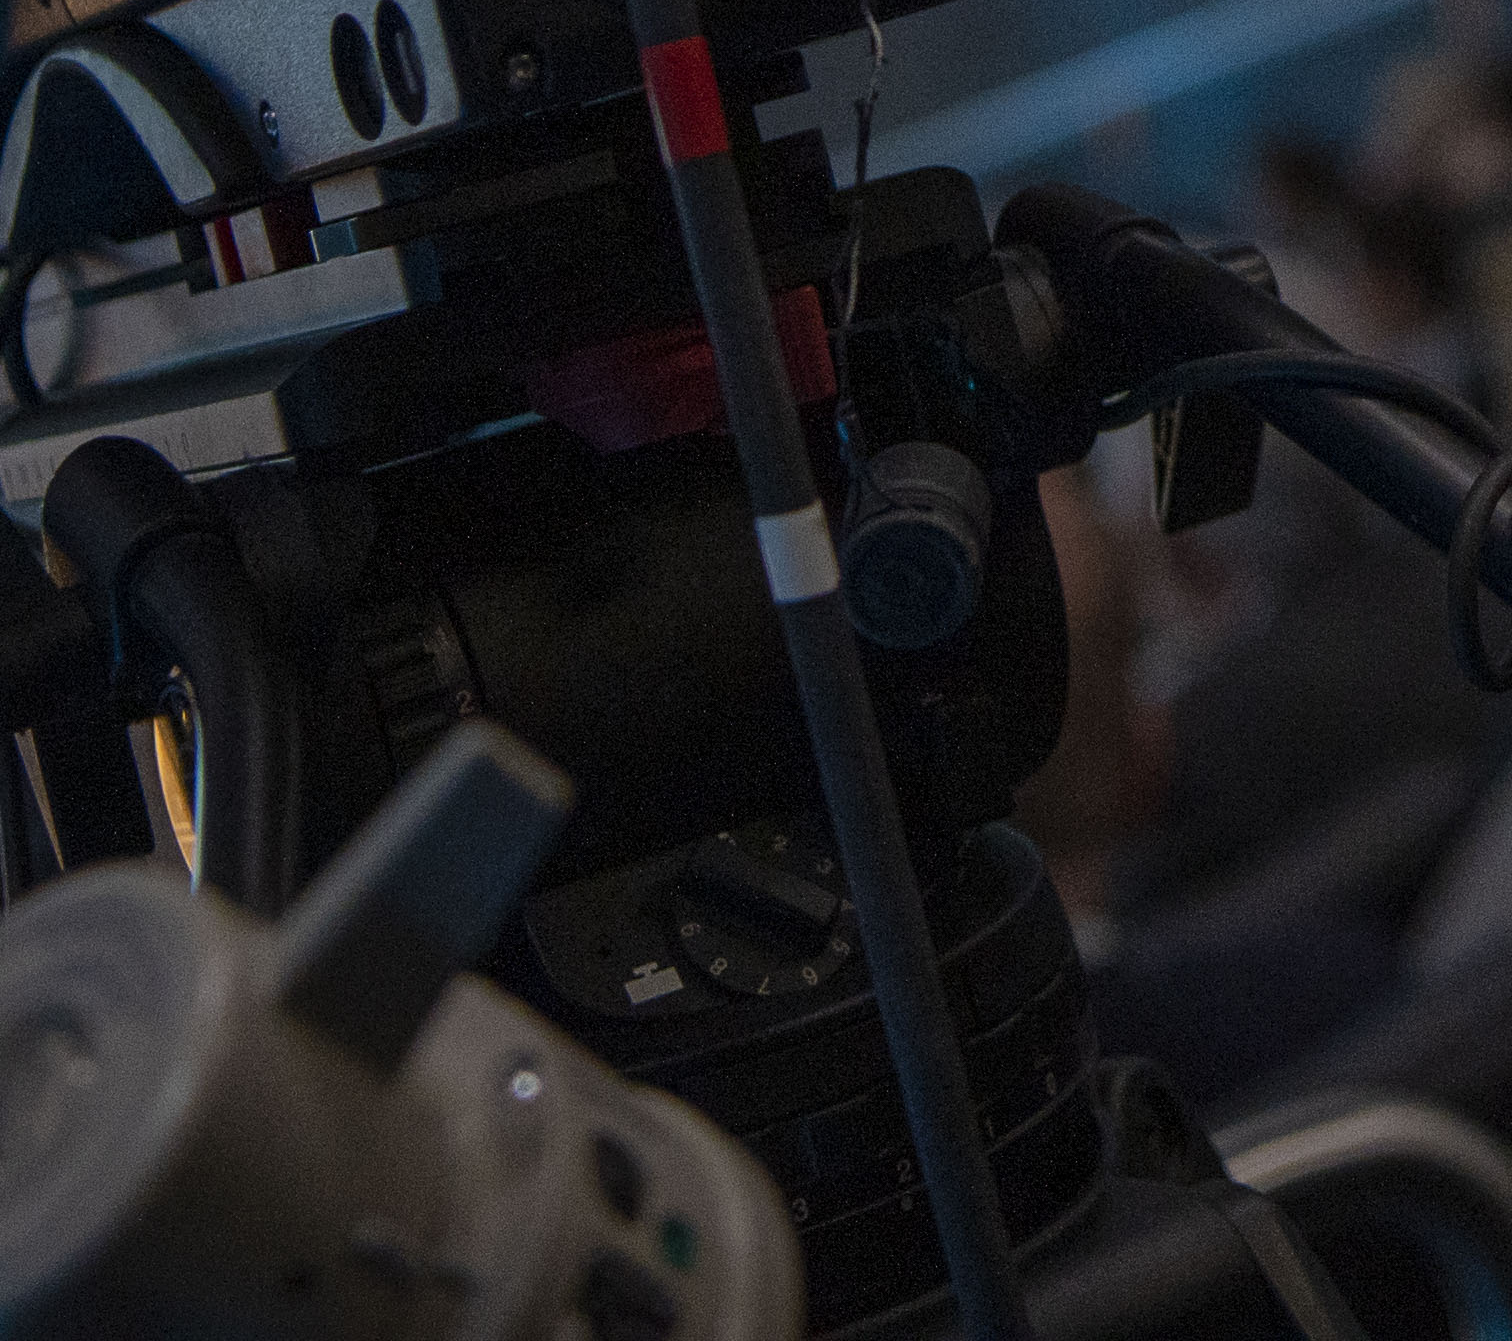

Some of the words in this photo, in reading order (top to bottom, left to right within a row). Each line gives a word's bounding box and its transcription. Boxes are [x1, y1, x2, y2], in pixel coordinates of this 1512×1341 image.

[709, 957, 729, 976] 8
[757, 975, 771, 996] 7
[895, 1157, 915, 1184] 2
[791, 1198, 810, 1223] 3
